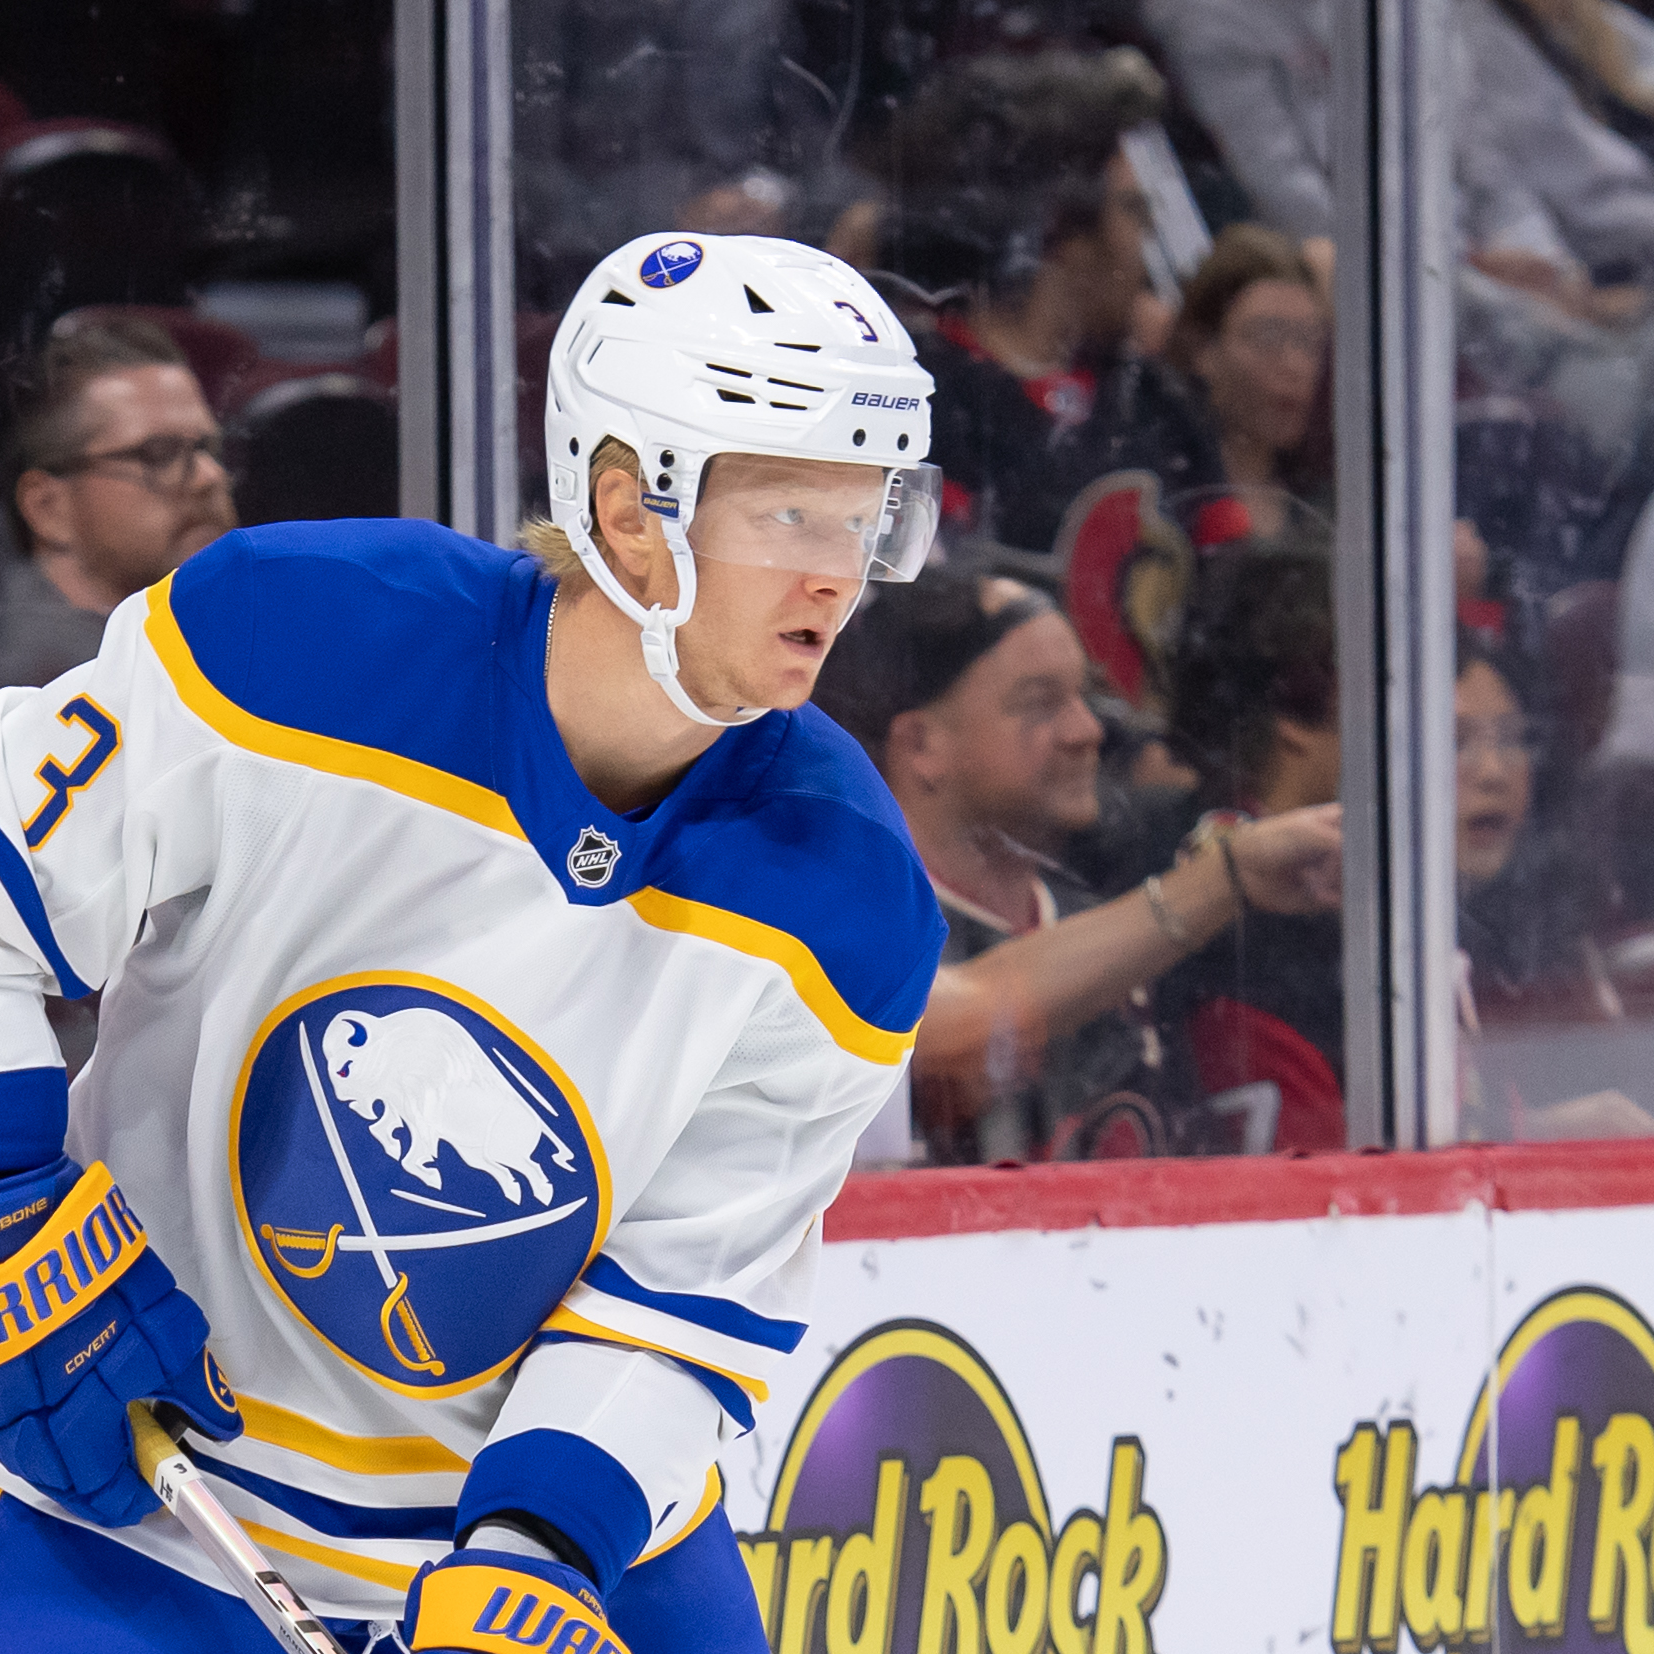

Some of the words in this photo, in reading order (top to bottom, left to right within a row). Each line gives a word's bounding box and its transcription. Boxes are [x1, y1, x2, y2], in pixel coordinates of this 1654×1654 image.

[834, 301, 879, 342] 3
[851, 392, 920, 411] BAUER
[21, 692, 123, 852] 3
[575, 852, 609, 868] NHL
[64, 1319, 119, 1377] COVERT
